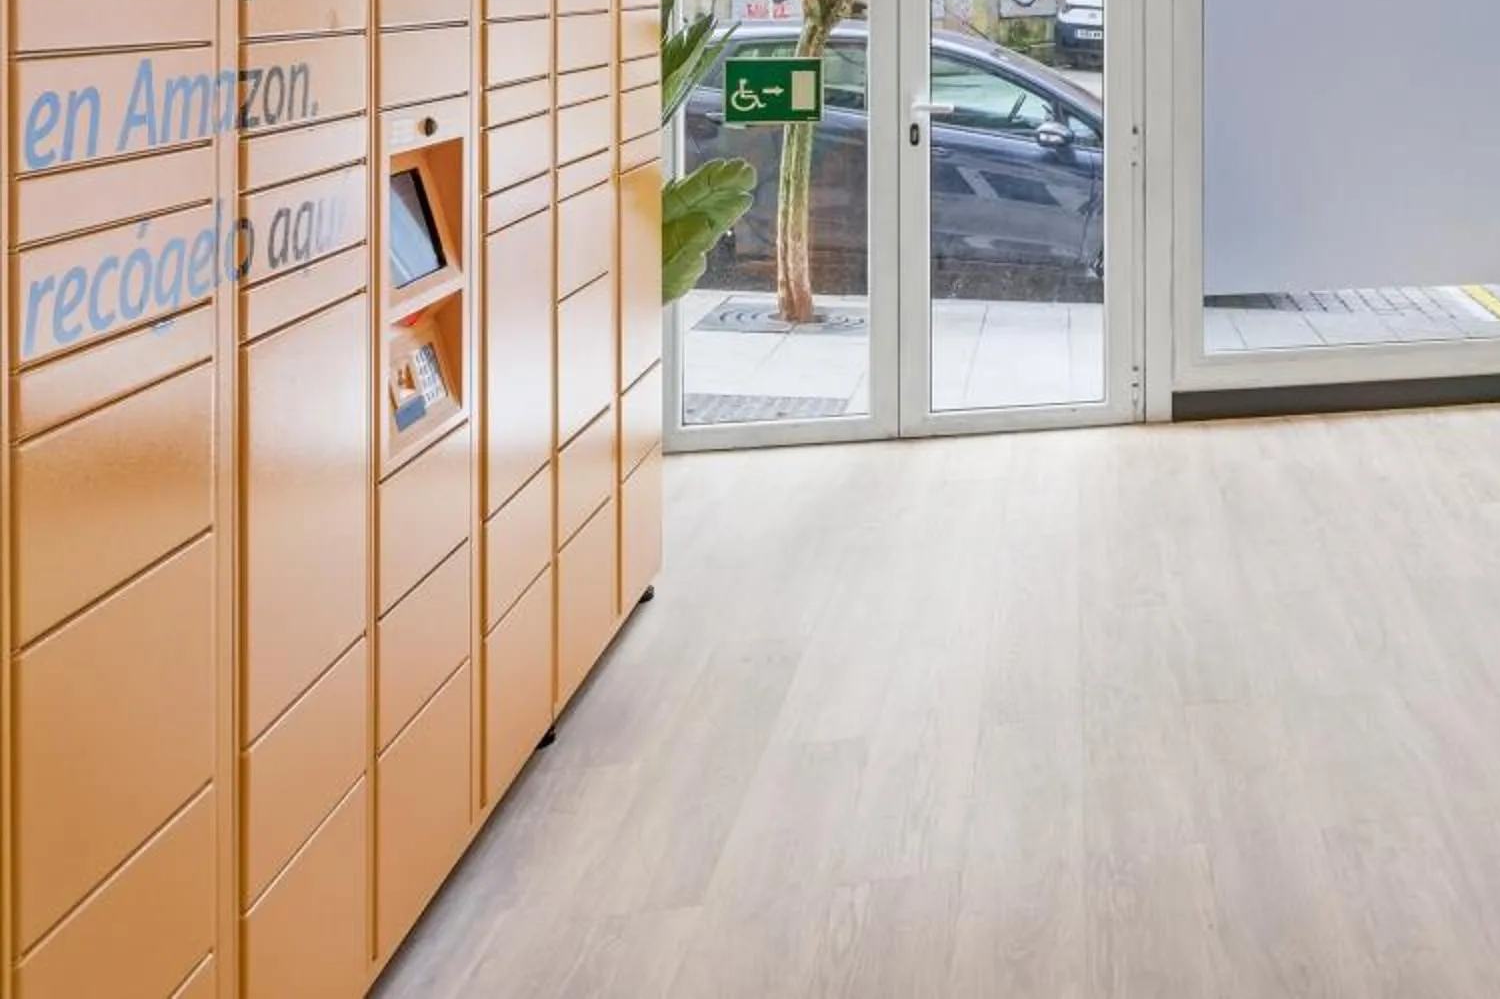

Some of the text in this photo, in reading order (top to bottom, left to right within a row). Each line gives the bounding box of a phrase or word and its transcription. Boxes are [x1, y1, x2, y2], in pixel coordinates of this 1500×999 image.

[24, 57, 320, 171] en Amazon.
[23, 200, 257, 356] recógelo
